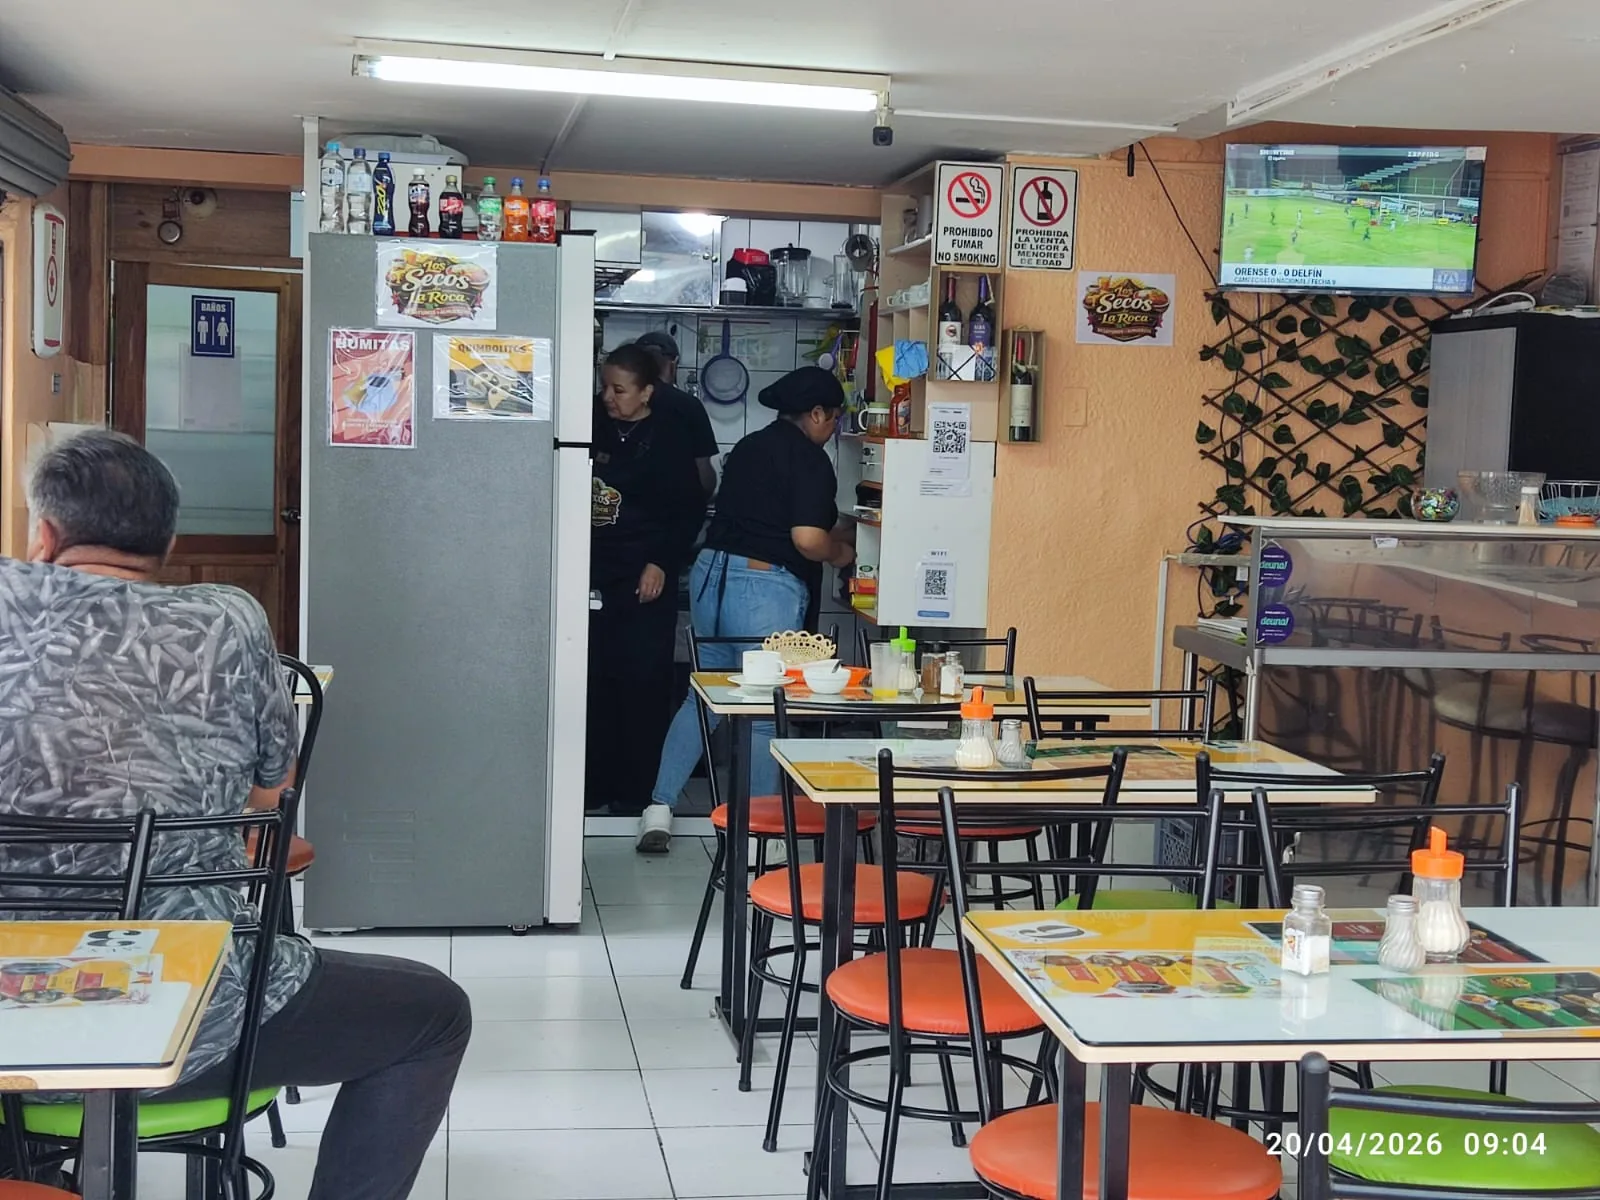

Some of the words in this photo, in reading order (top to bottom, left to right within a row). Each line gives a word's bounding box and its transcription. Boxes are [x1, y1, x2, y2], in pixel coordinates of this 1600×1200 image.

[943, 226, 993, 238] PROHIBIDO
[1015, 228, 1069, 238] PROHIBIDA
[951, 239, 983, 250] FUMAR
[938, 252, 951, 261] NO
[954, 252, 996, 264] SMOKING
[422, 261, 446, 272] Los
[1234, 267, 1269, 276] ORENSE
[1271, 268, 1277, 276] 0
[1284, 268, 1290, 277] 0
[1292, 268, 1322, 277] DELFÍN
[402, 268, 468, 291] Secos
[1114, 286, 1134, 297] Los
[428, 291, 466, 304] Roca
[201, 302, 226, 312] BAÑOS
[1096, 294, 1153, 313] Secos
[1101, 313, 1116, 324] La
[1117, 313, 1148, 324] Roca
